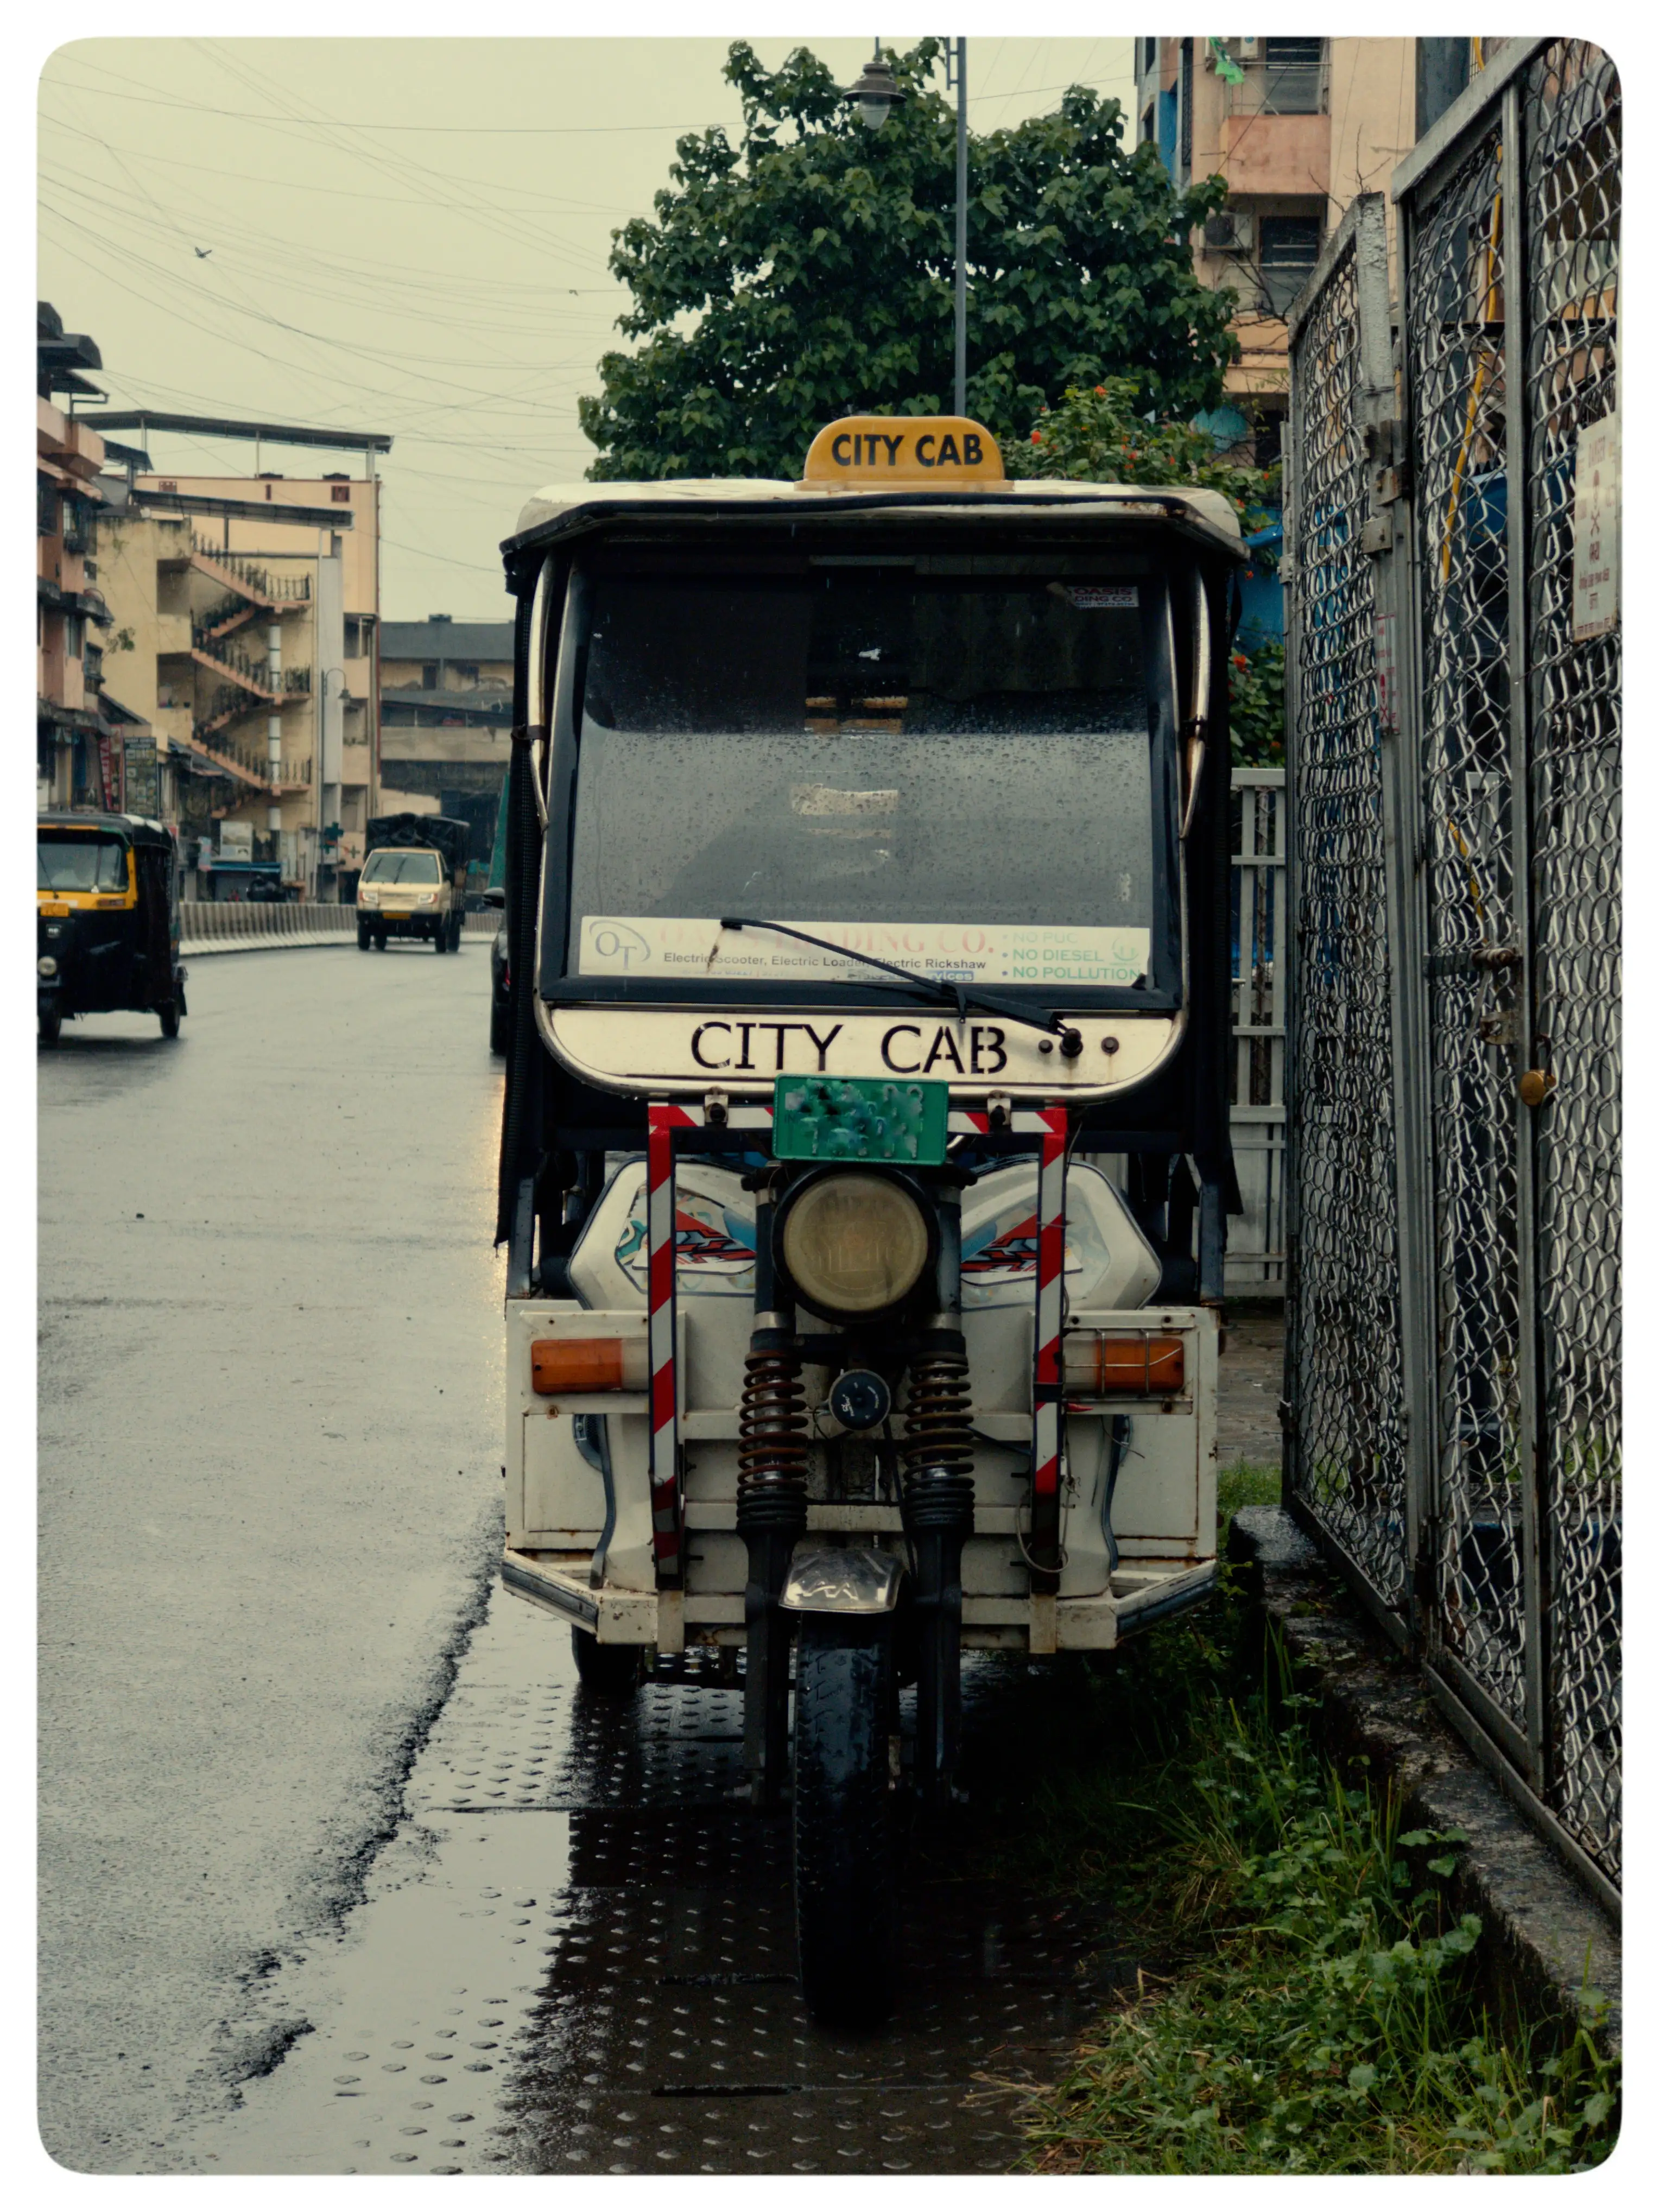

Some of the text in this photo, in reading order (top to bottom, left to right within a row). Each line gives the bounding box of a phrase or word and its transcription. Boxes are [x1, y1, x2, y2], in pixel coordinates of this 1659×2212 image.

[831, 434, 984, 467] CITY CAB
[1074, 587, 1132, 595] OASIS
[938, 928, 995, 954] CO.
[1012, 932, 1078, 944] NO PUC
[664, 953, 710, 964] Electric
[771, 955, 818, 966] Electric
[925, 959, 986, 969] Rickshaw
[1012, 949, 1104, 962] NO DIESEL
[1012, 966, 1139, 980] NO POLLUTION
[691, 1021, 1008, 1074] CITY CAB
